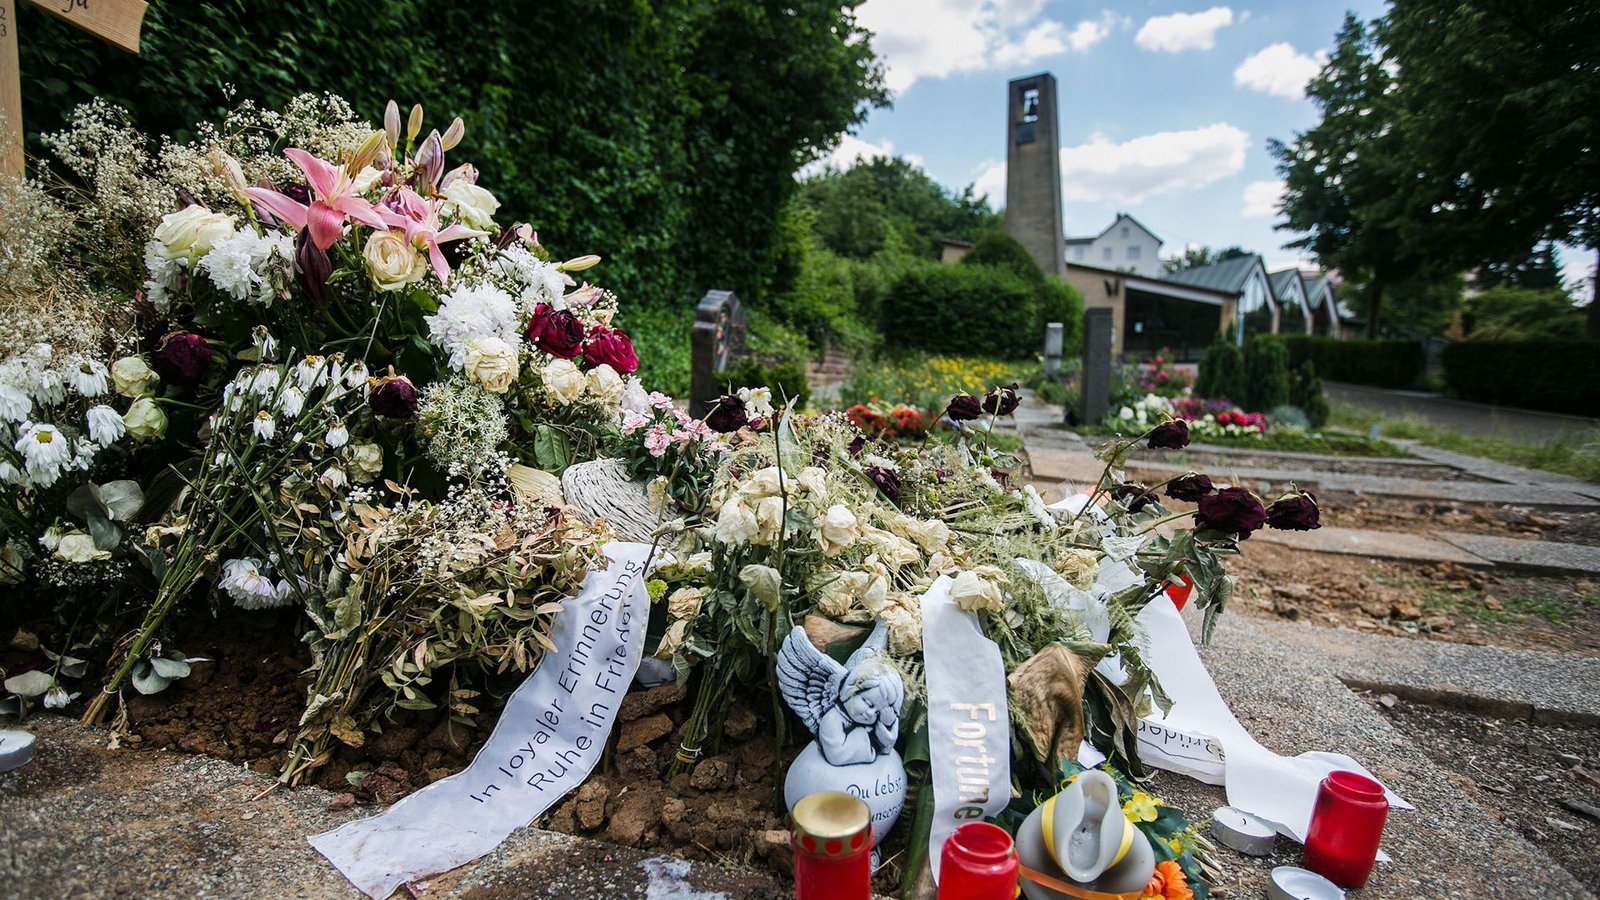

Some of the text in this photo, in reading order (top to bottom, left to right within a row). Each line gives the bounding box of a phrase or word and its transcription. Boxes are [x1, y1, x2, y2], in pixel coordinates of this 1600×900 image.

[470, 783, 501, 802] In
[498, 698, 565, 777] loyaler
[526, 735, 593, 791] Ruhe
[580, 703, 610, 728] in
[846, 784, 870, 799] Du
[950, 702, 997, 820] Fortune
